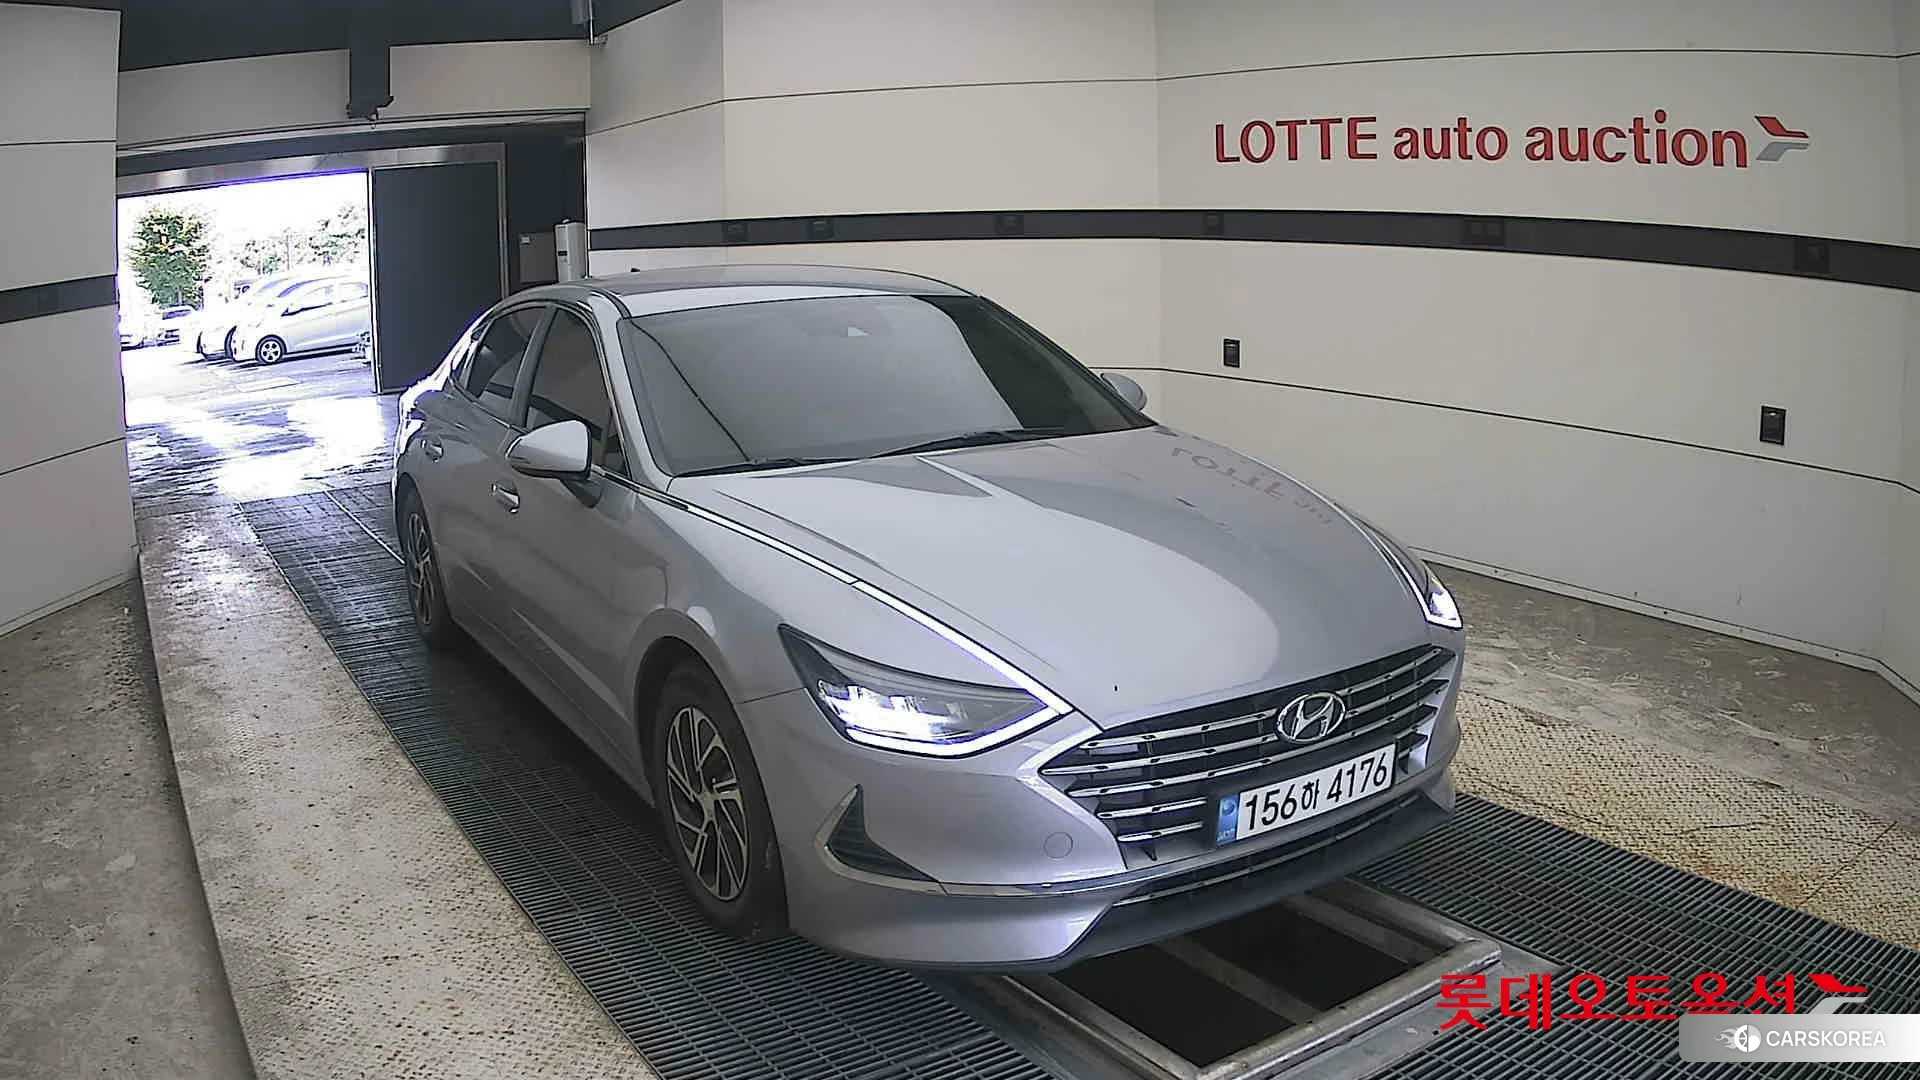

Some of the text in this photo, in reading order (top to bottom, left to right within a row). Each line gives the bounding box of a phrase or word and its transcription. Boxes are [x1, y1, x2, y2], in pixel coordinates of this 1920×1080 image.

[1214, 109, 1748, 169] LOTTE auto auction
[1245, 752, 1388, 831] 156하 4176
